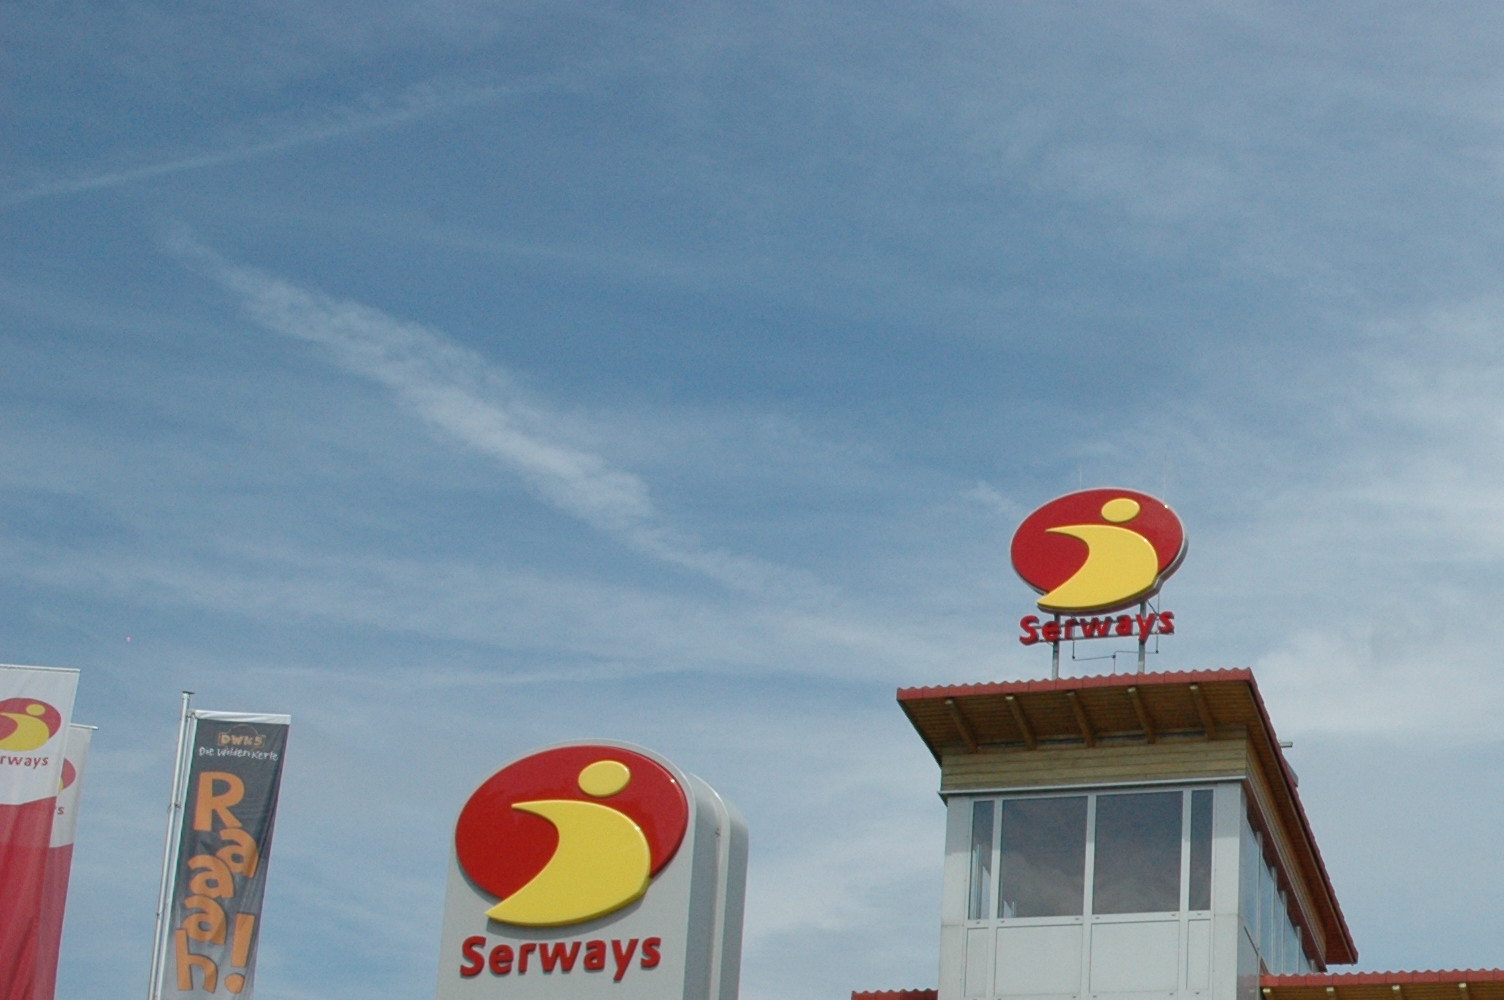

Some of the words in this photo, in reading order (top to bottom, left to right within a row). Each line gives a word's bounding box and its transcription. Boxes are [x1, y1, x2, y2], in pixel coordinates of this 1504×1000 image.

[1019, 611, 1175, 645] Serways
[0, 755, 49, 770] rways
[460, 936, 662, 983] Serways
